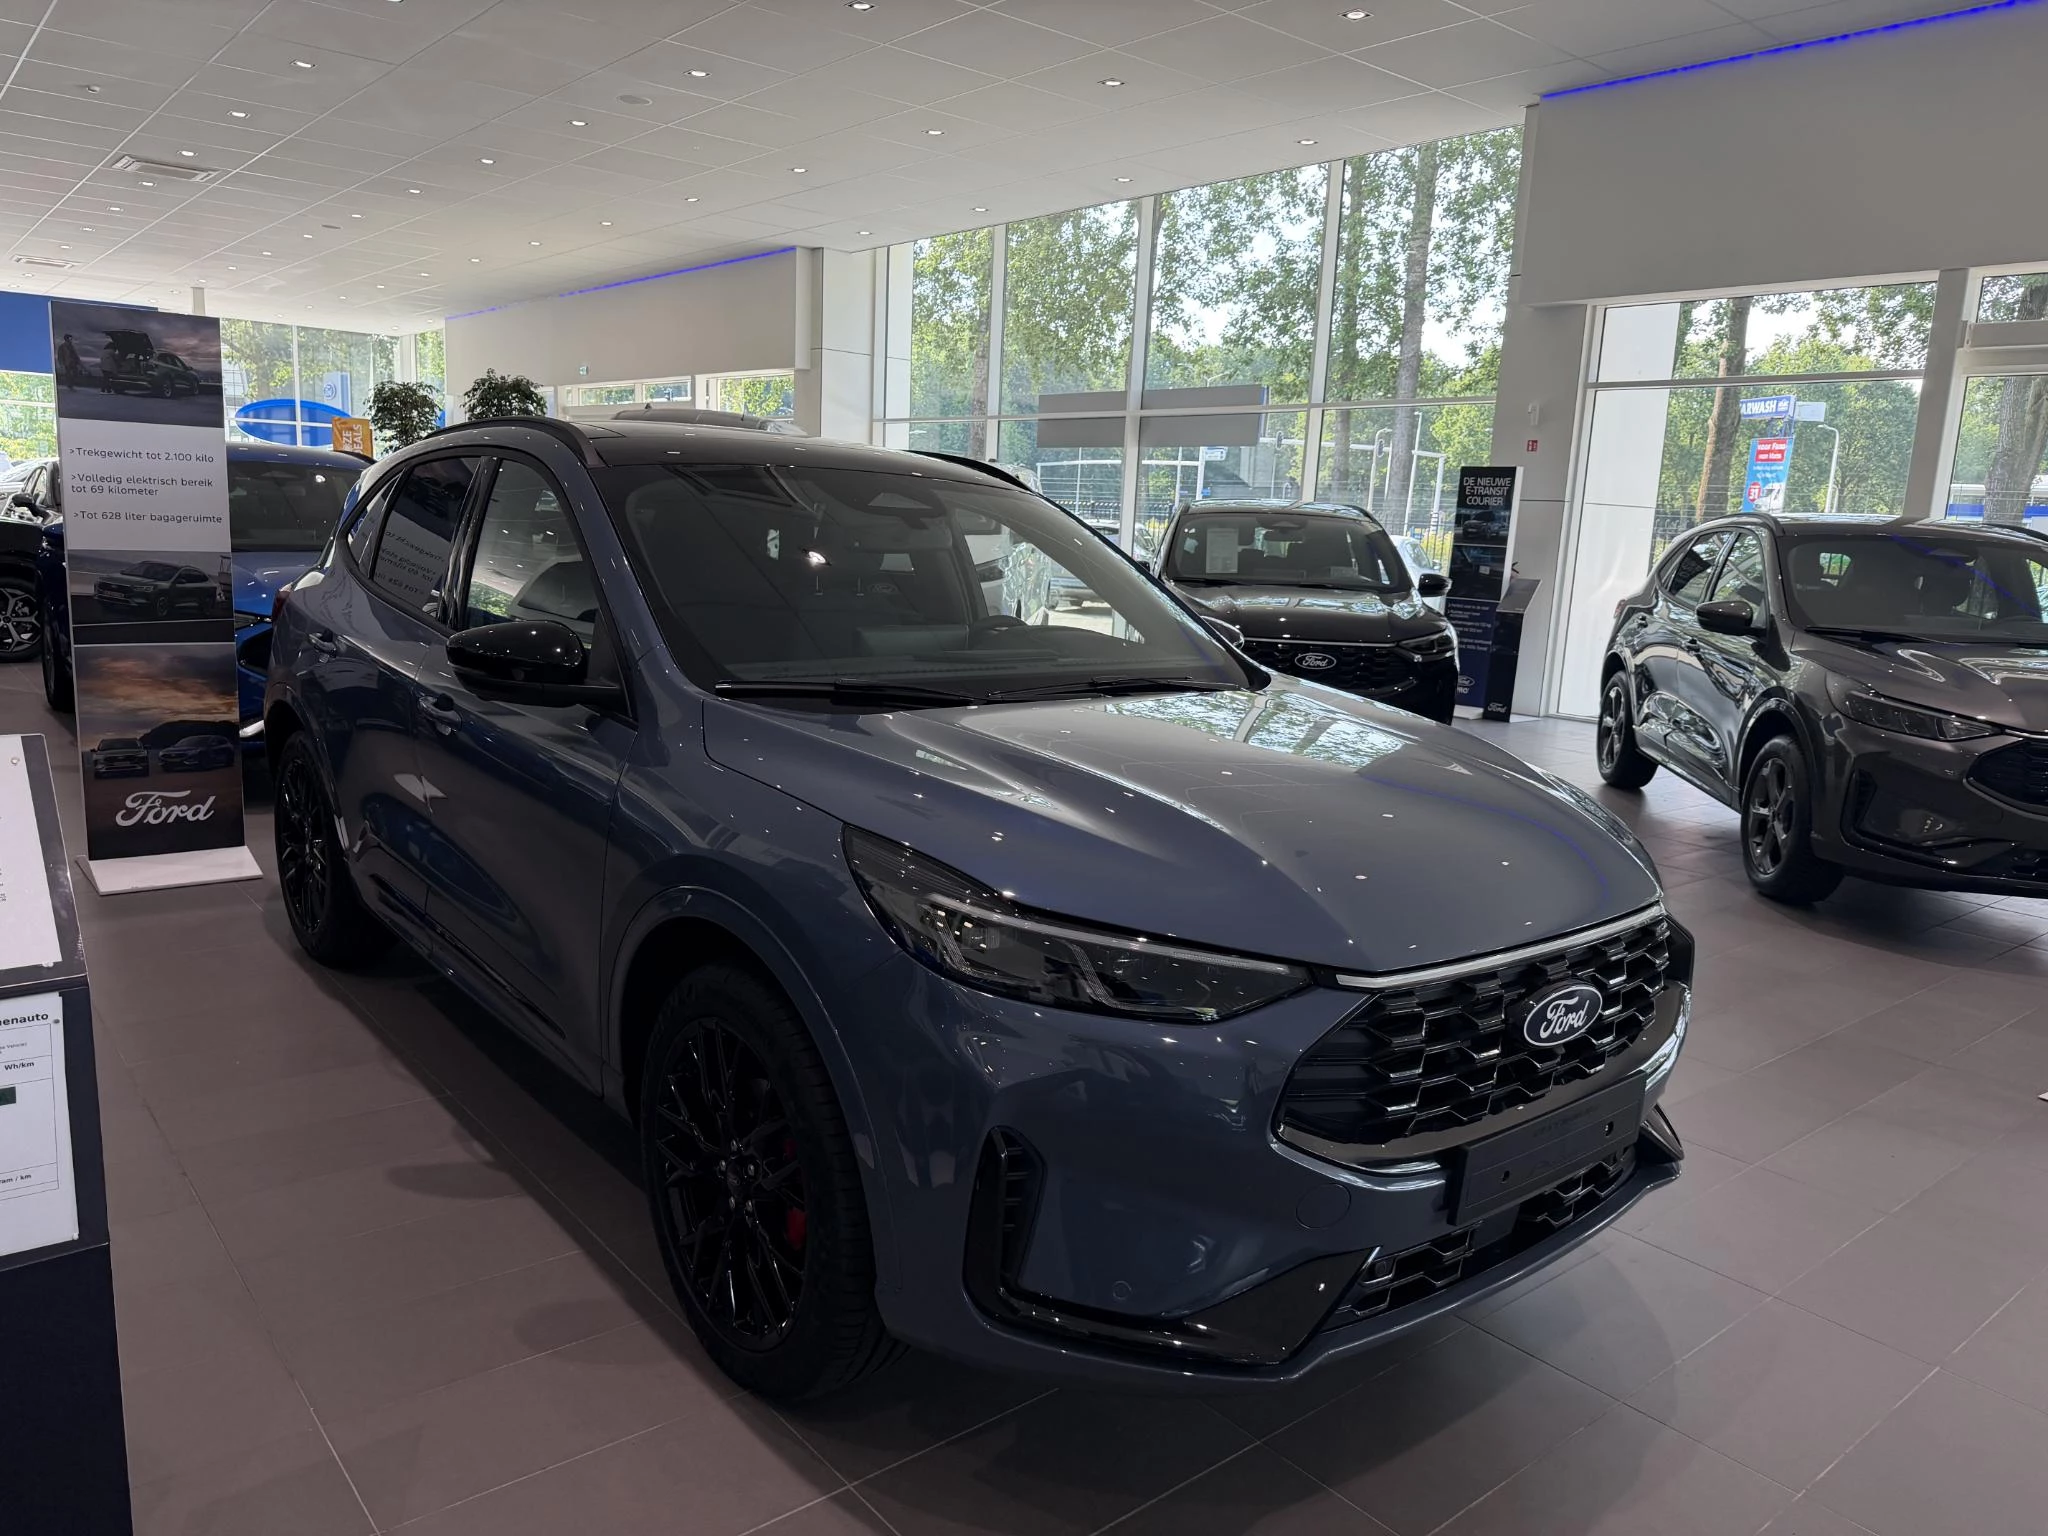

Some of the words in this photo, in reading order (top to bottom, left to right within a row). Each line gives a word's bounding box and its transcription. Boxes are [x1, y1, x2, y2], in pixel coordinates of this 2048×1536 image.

[1740, 400, 1777, 415] ARWASH
[69, 447, 143, 459] >Trekgewicht
[146, 452, 161, 460] tot
[164, 452, 192, 462] 2.100
[195, 453, 214, 463] kilo
[71, 473, 123, 484] >Volledig
[126, 475, 178, 486] elektrisch
[181, 477, 213, 487] bereik
[1463, 477, 1476, 486] DE
[1477, 477, 1512, 487] NIEUWE
[71, 485, 87, 494] tot
[90, 485, 104, 494] 69
[108, 486, 158, 496] kilometer
[1465, 486, 1509, 496] E-TRANSIT
[1466, 496, 1504, 506] COURIER
[73, 510, 99, 520] >Tot
[101, 511, 121, 520] 628
[125, 512, 146, 521] liter
[150, 513, 222, 524] bagageruimte
[1302, 655, 1329, 667] Ford
[1487, 702, 1507, 713] Ford
[115, 790, 216, 827] Ford
[1539, 996, 1590, 1039] Ford
[4, 1061, 35, 1071] Wh/km
[20, 1173, 32, 1181] km
